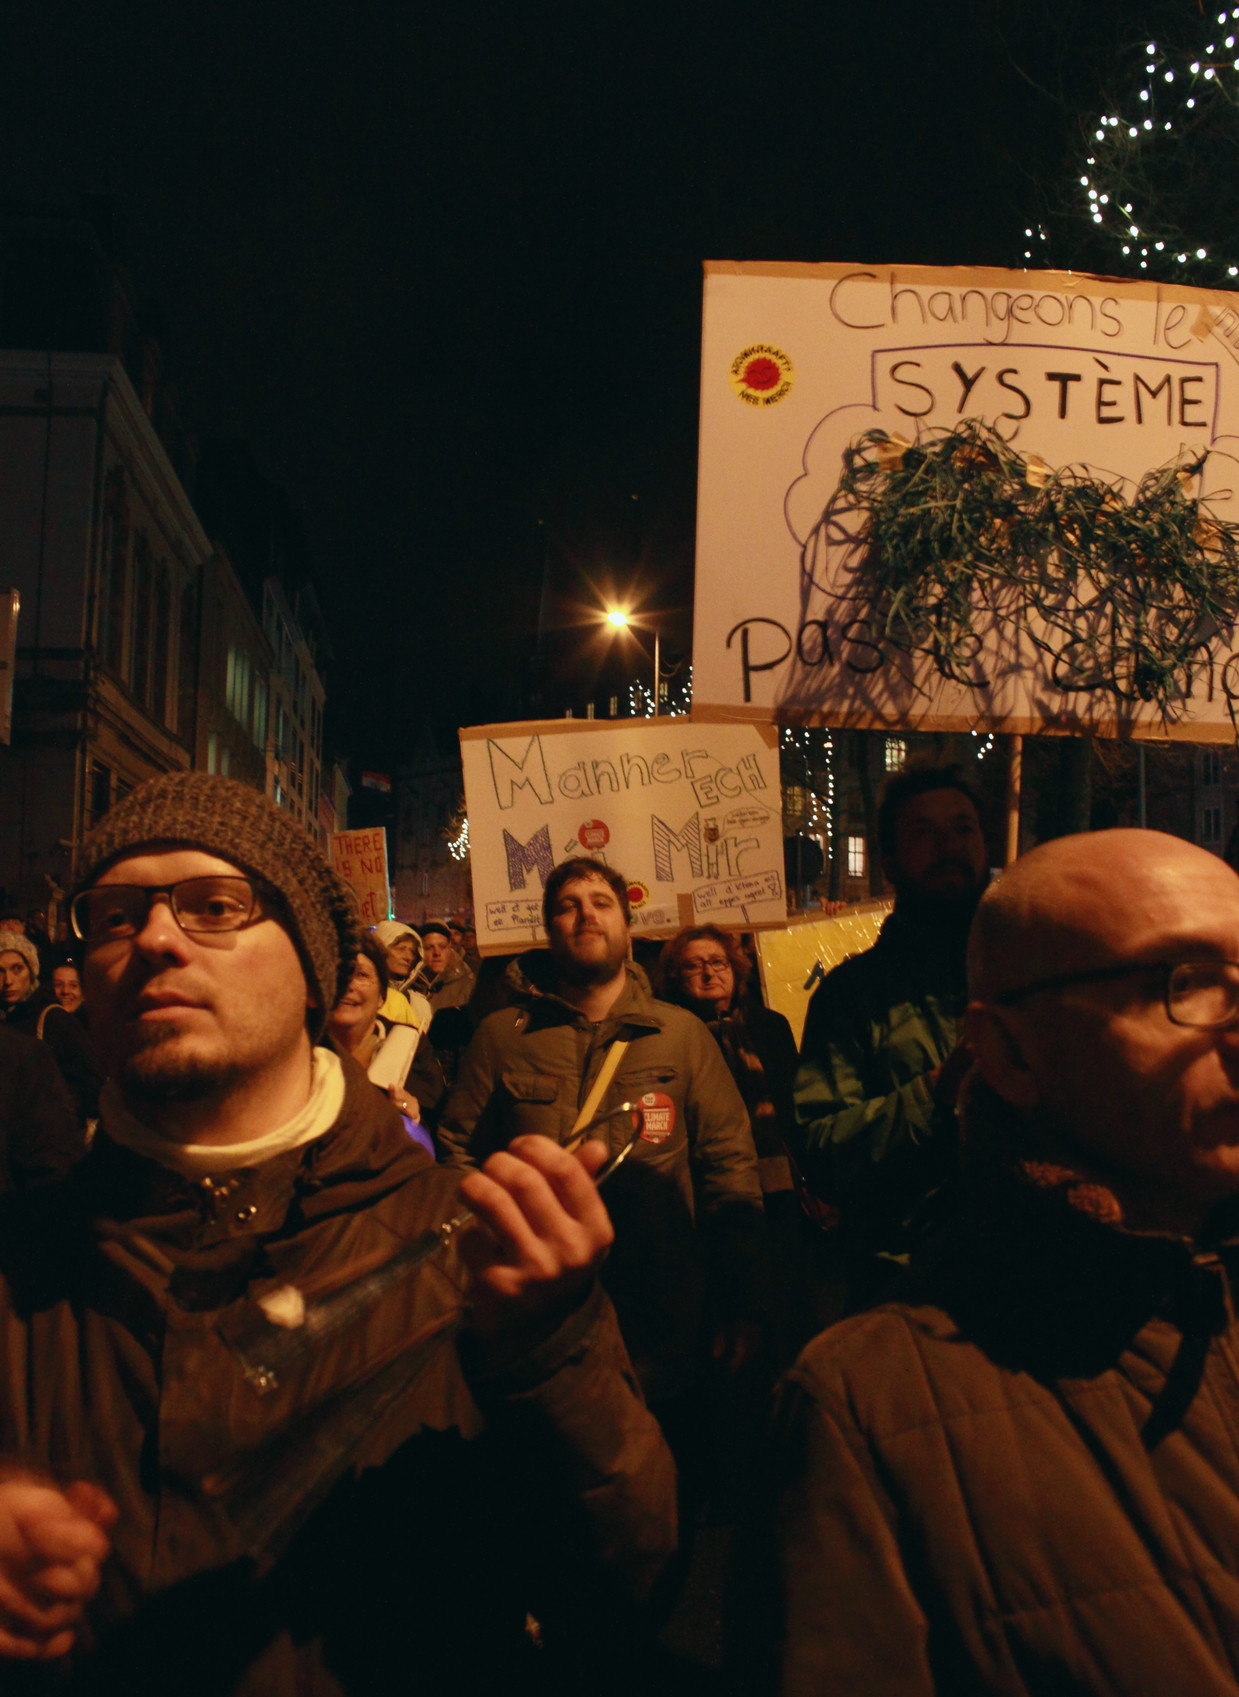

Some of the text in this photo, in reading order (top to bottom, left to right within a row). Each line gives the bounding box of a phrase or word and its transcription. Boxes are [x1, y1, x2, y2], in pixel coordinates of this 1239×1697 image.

[829, 272, 1122, 346] Changeons
[1153, 285, 1192, 350] le
[889, 356, 1208, 427] SYSTÈME
[333, 832, 383, 856] THERE
[359, 856, 384, 875] NO
